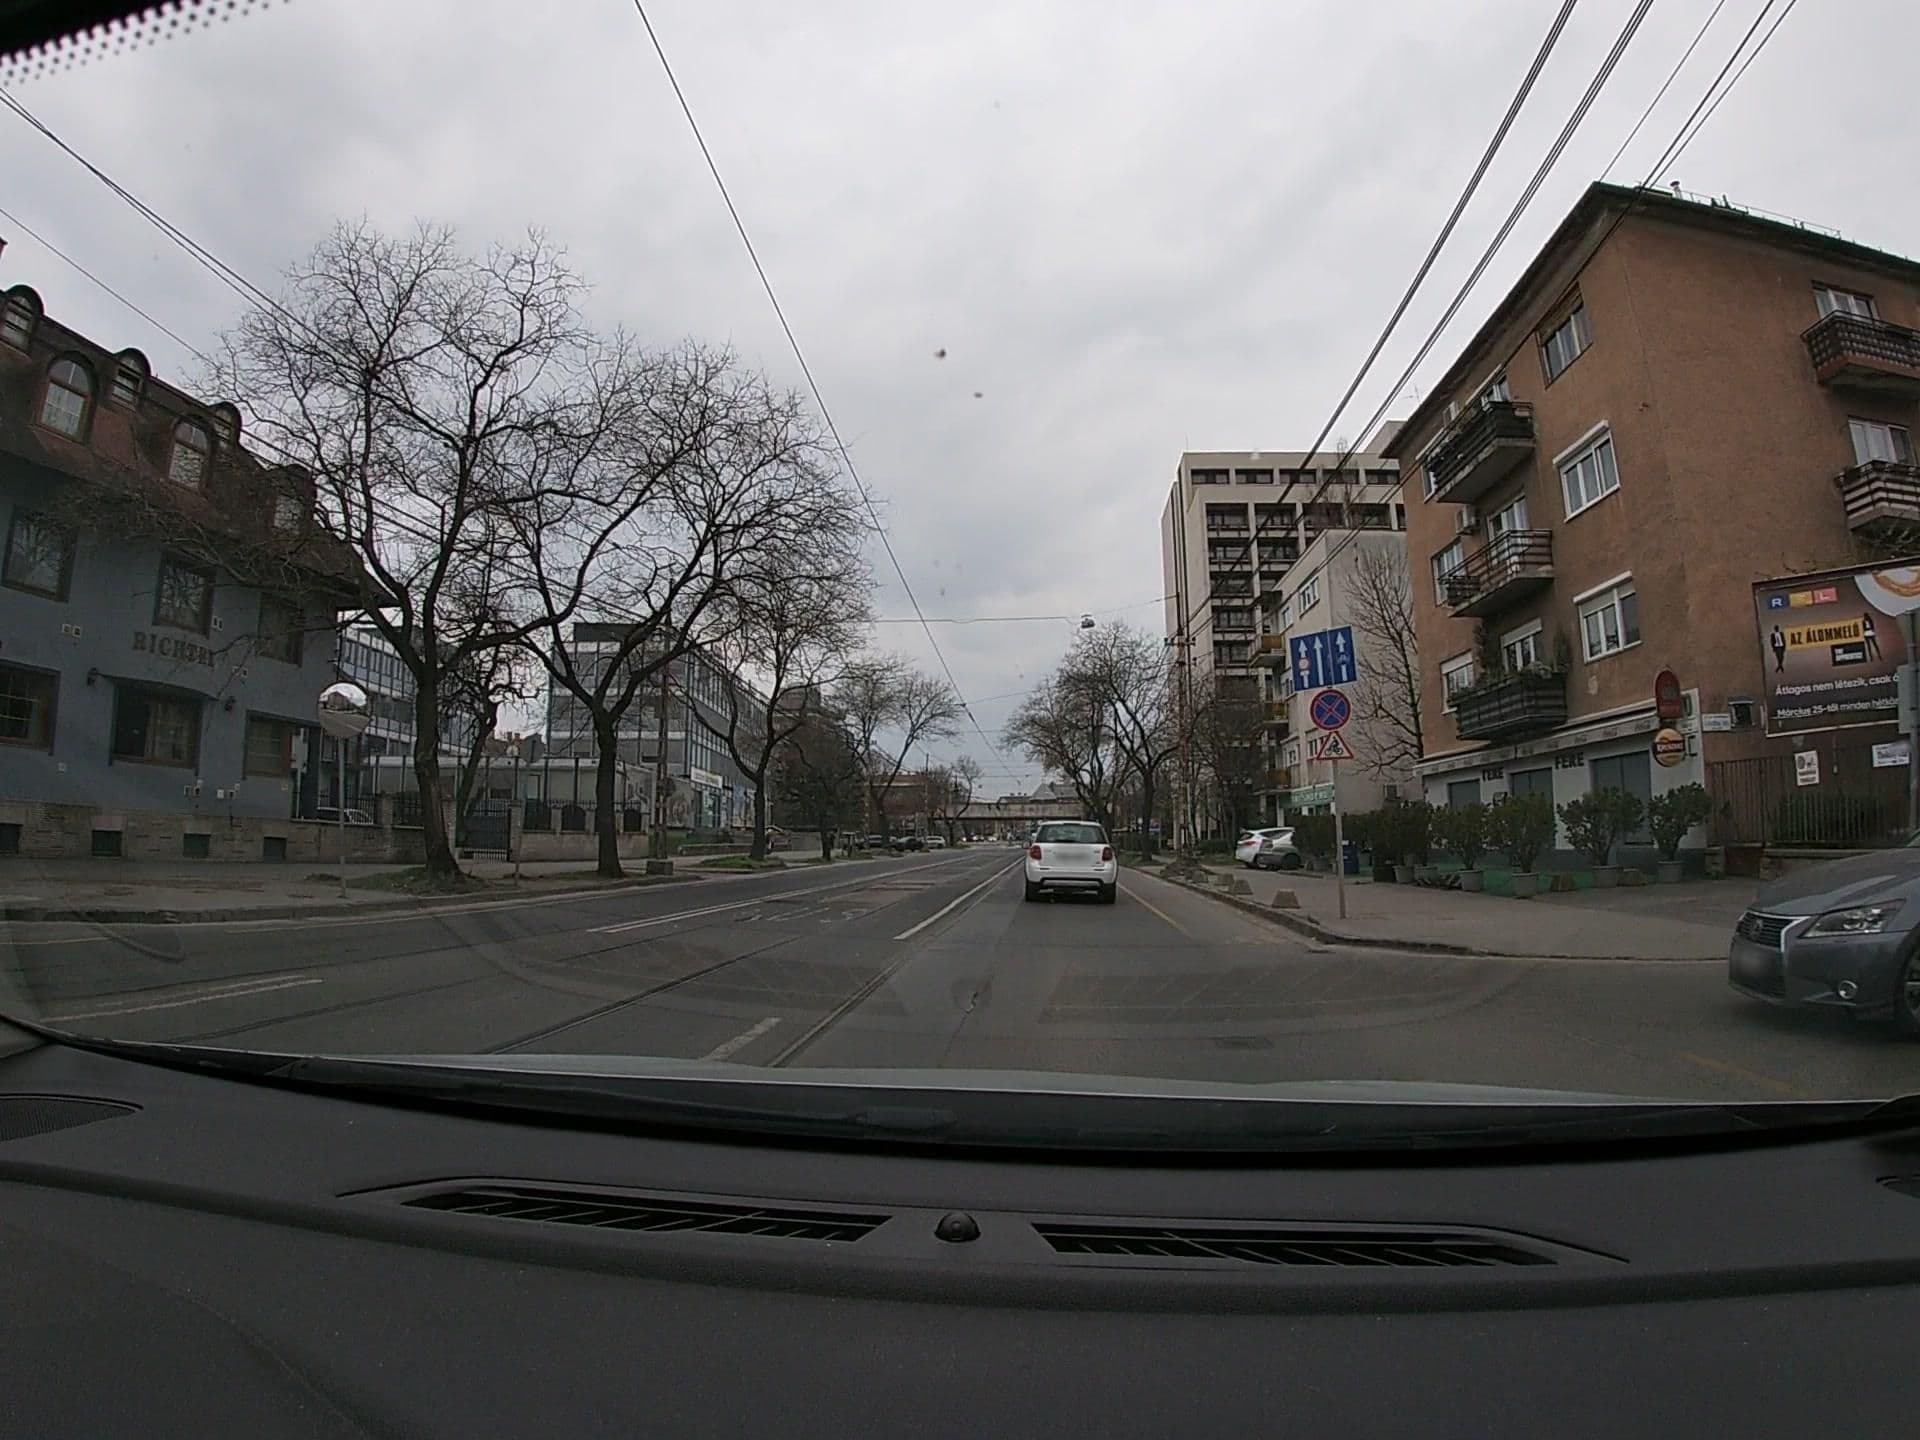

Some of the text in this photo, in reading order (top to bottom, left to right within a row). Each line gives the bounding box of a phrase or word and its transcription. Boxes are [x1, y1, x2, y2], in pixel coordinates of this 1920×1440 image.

[1790, 622, 1860, 646] AZ ÁLOMMELÓ
[1776, 684, 1811, 696] Átlagos
[1813, 682, 1834, 692] nem
[1869, 675, 1891, 685] csak
[1840, 702, 1870, 711] minden
